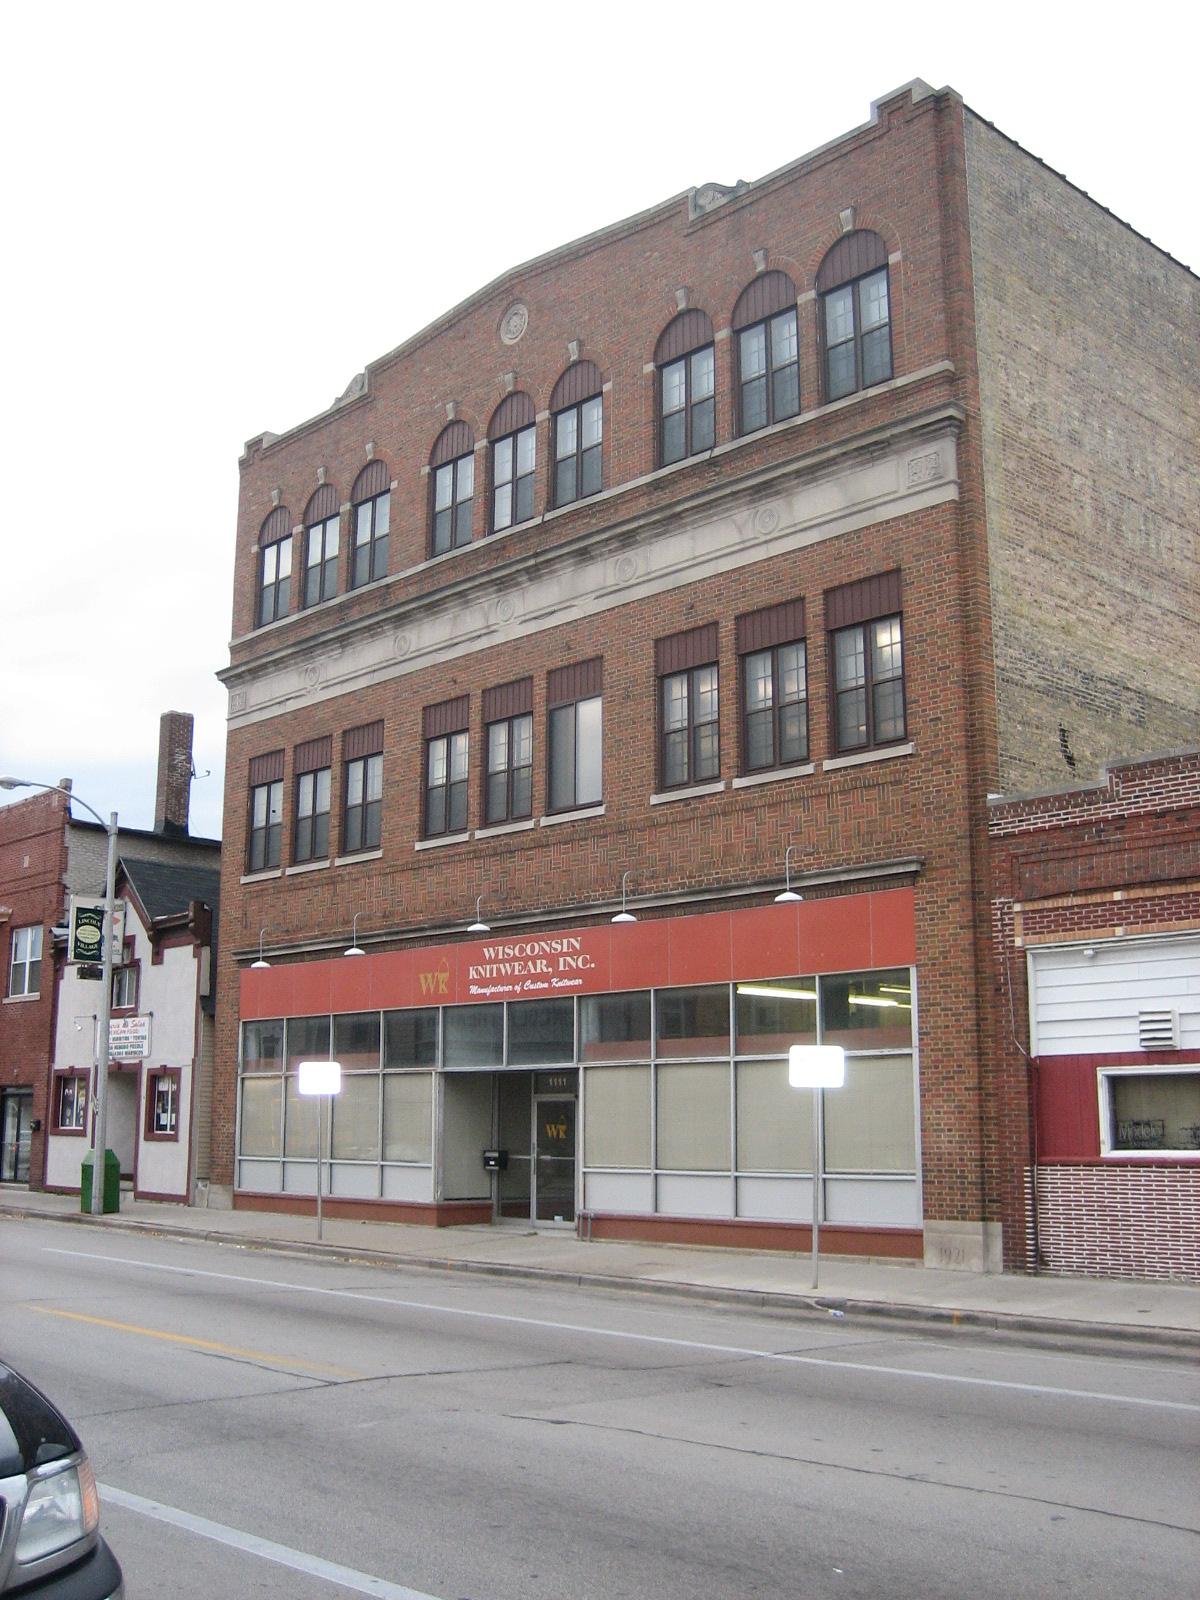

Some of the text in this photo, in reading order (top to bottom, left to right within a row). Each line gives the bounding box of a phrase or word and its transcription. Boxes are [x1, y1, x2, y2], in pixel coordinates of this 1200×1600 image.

[78, 919, 101, 927] LINCOLN
[77, 942, 98, 950] VILLAGE
[483, 937, 582, 960] WISCONSIN
[469, 955, 595, 979] KNITWEAR, INC.
[419, 972, 449, 996] WK
[470, 978, 583, 996] Manufacturer of Custom Knitwear
[546, 1123, 567, 1138] WK
